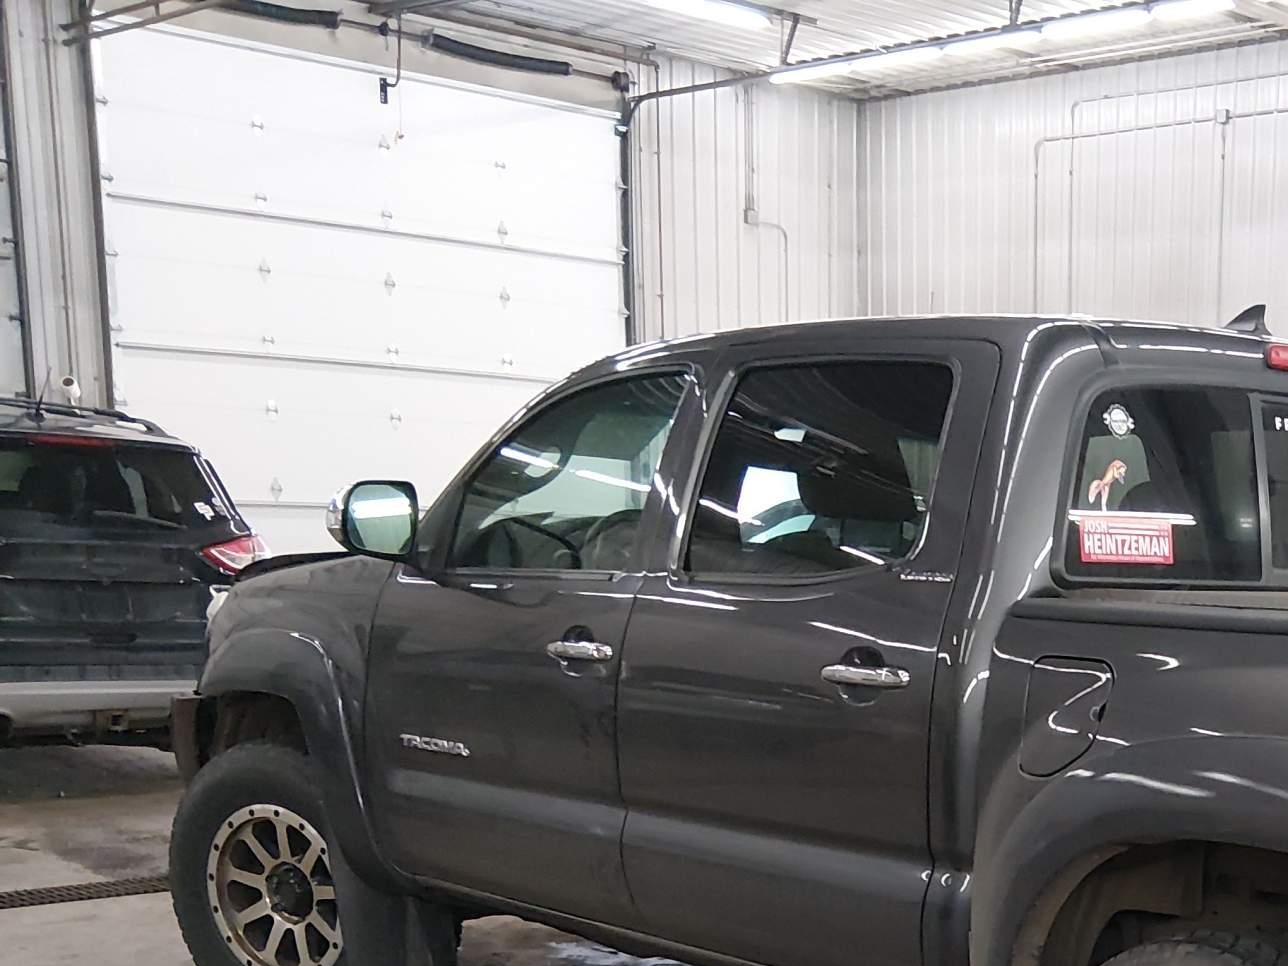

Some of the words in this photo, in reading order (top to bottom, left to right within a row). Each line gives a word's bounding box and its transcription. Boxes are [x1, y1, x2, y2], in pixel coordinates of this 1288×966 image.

[1084, 519, 1108, 533] JOSH
[1084, 533, 1170, 557] HEINTZEMAN
[400, 733, 470, 757] TACOMA
